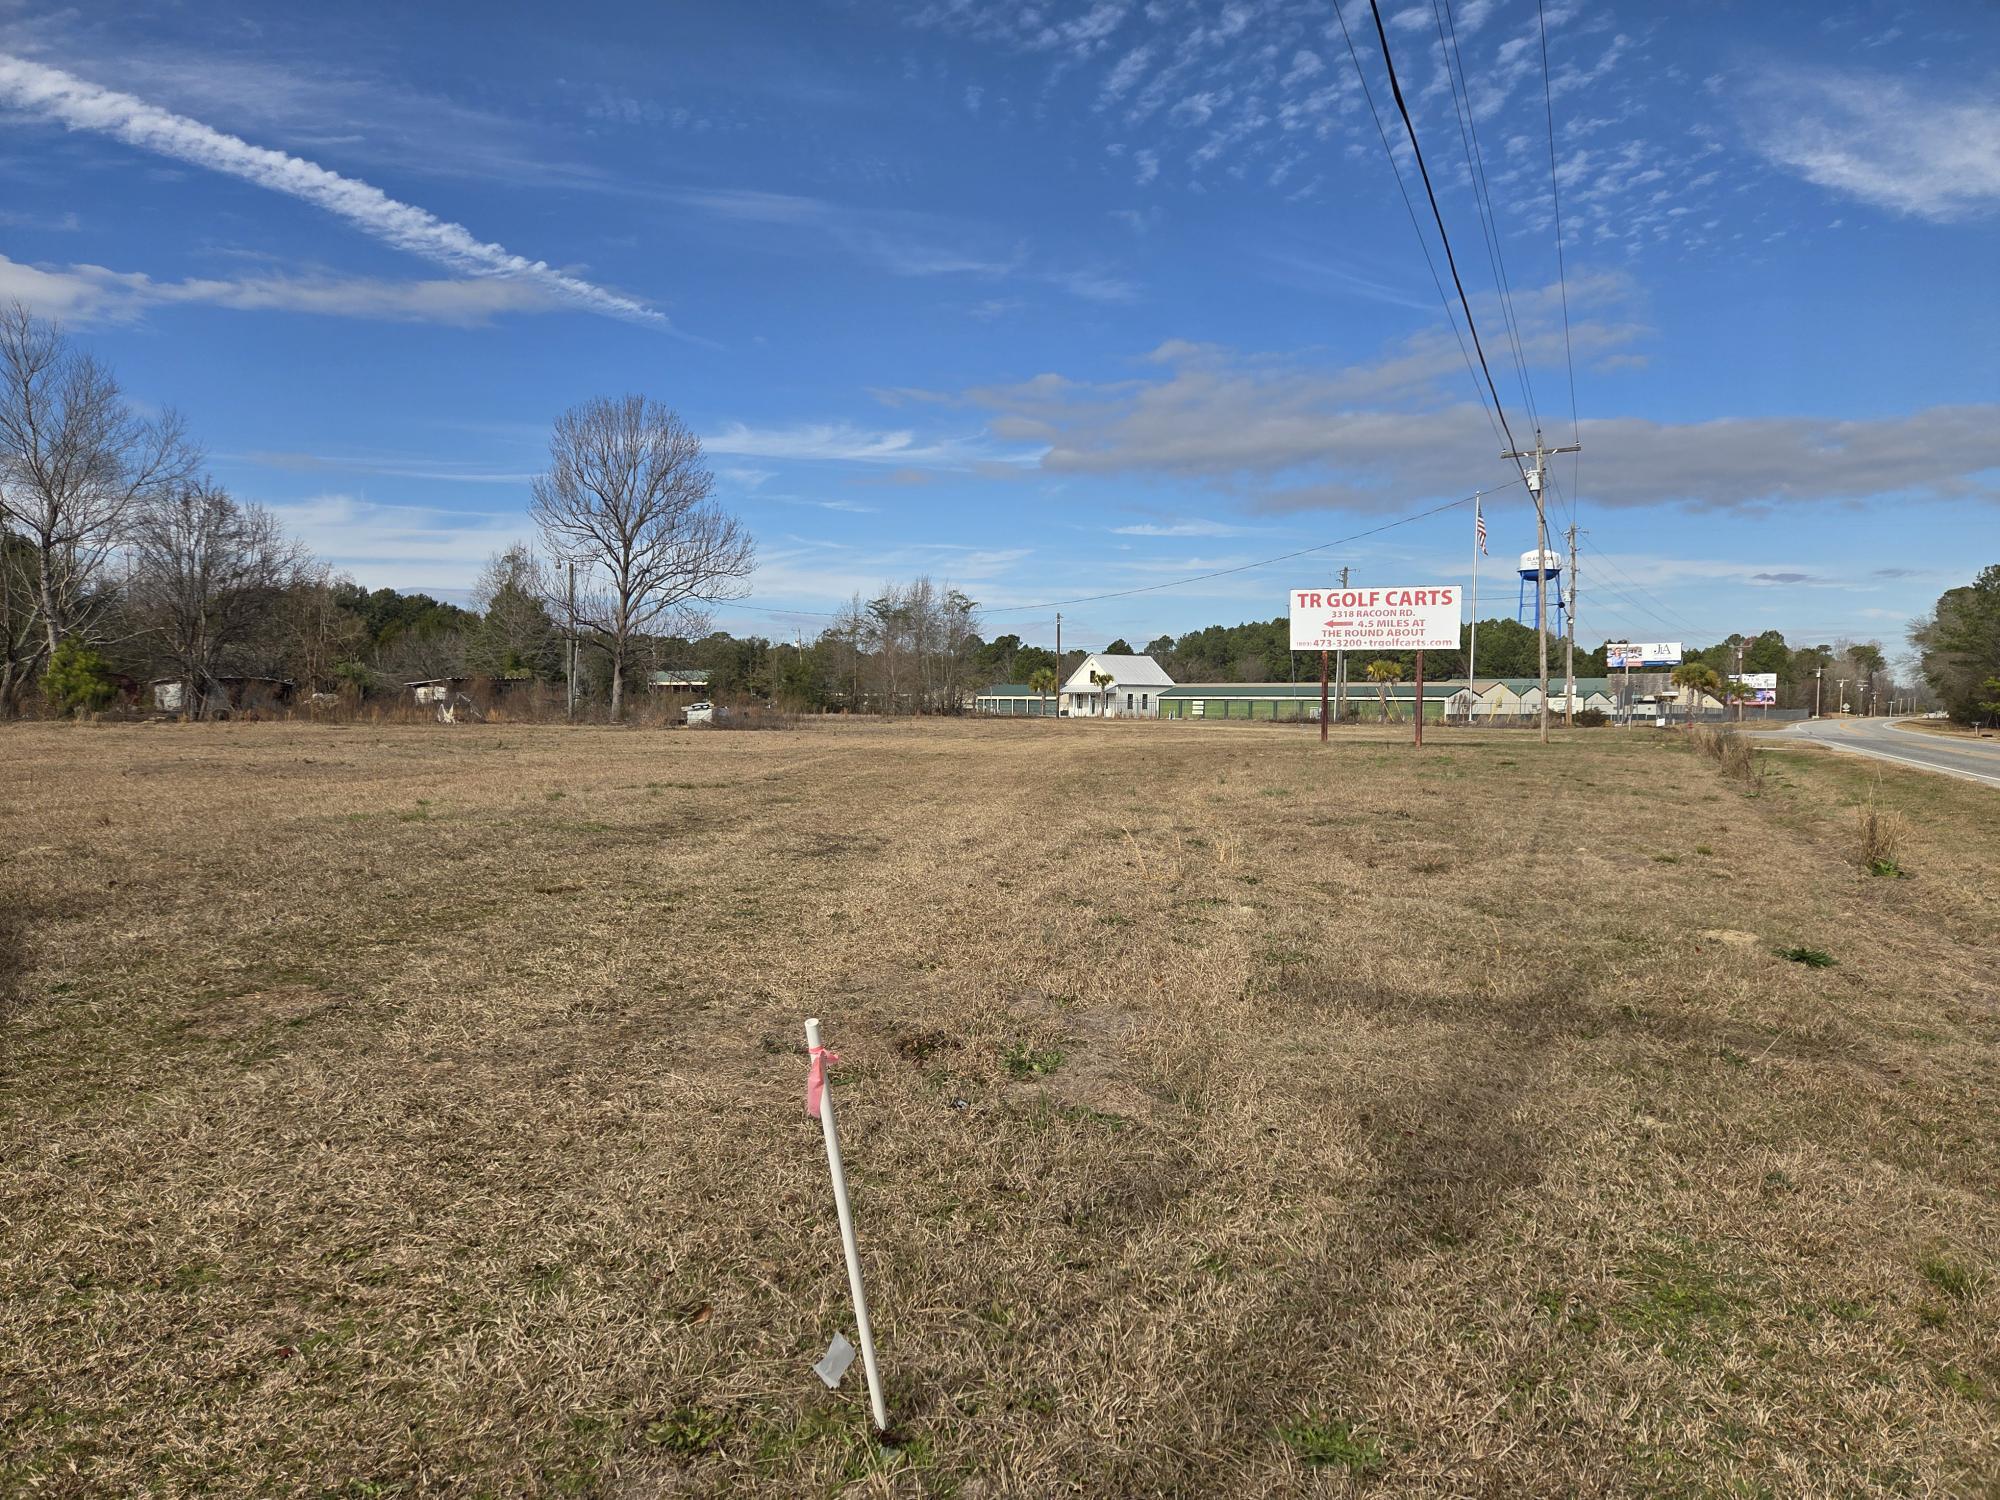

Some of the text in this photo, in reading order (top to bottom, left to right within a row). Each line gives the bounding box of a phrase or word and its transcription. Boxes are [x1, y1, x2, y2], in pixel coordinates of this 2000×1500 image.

[1297, 590, 1453, 608] TR GOLF CARTS
[1331, 609, 1416, 618] 3318 RACOON RD.
[1358, 619, 1426, 628] 4.5 MILES AT
[1322, 628, 1426, 637] THE ROUND ABOUT
[1313, 639, 1362, 647] 473-3200
[1369, 638, 1453, 647] trgolfcarts.com
